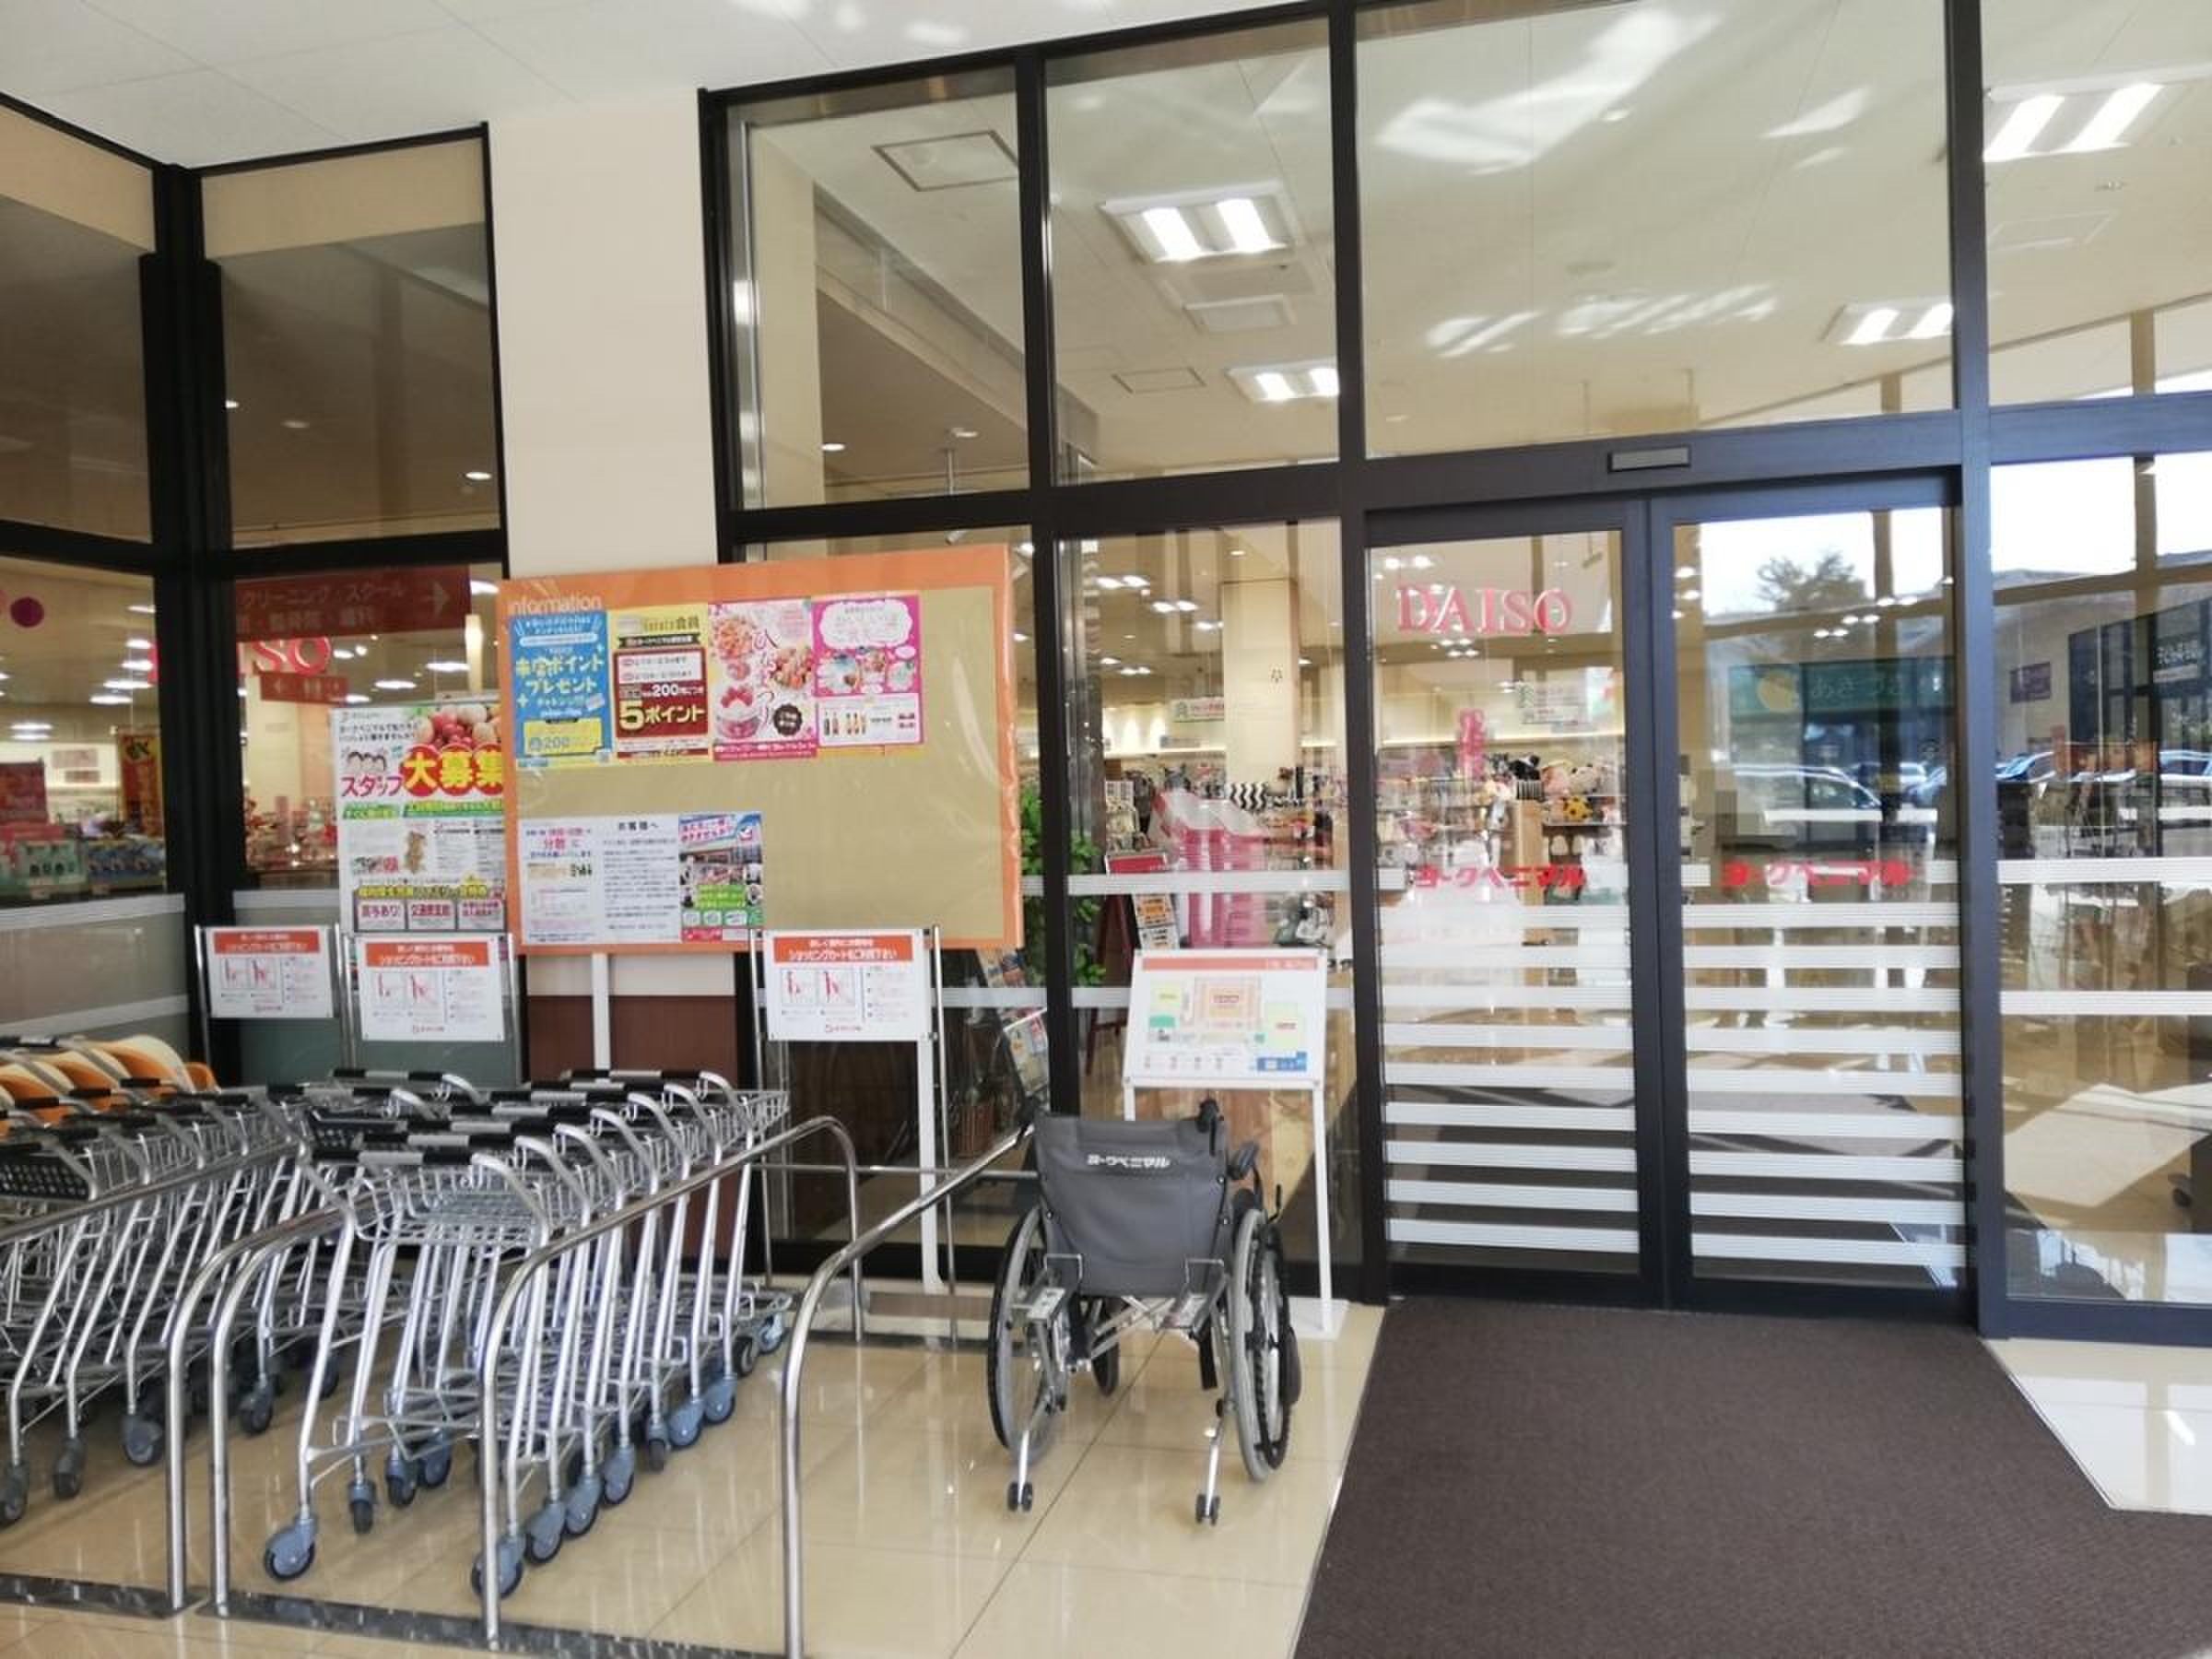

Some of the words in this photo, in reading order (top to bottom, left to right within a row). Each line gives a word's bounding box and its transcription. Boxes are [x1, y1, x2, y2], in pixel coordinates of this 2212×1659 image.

[1397, 584, 1572, 635] DAISO
[619, 700, 705, 732] 5ポイント
[341, 775, 403, 797] スタッフ
